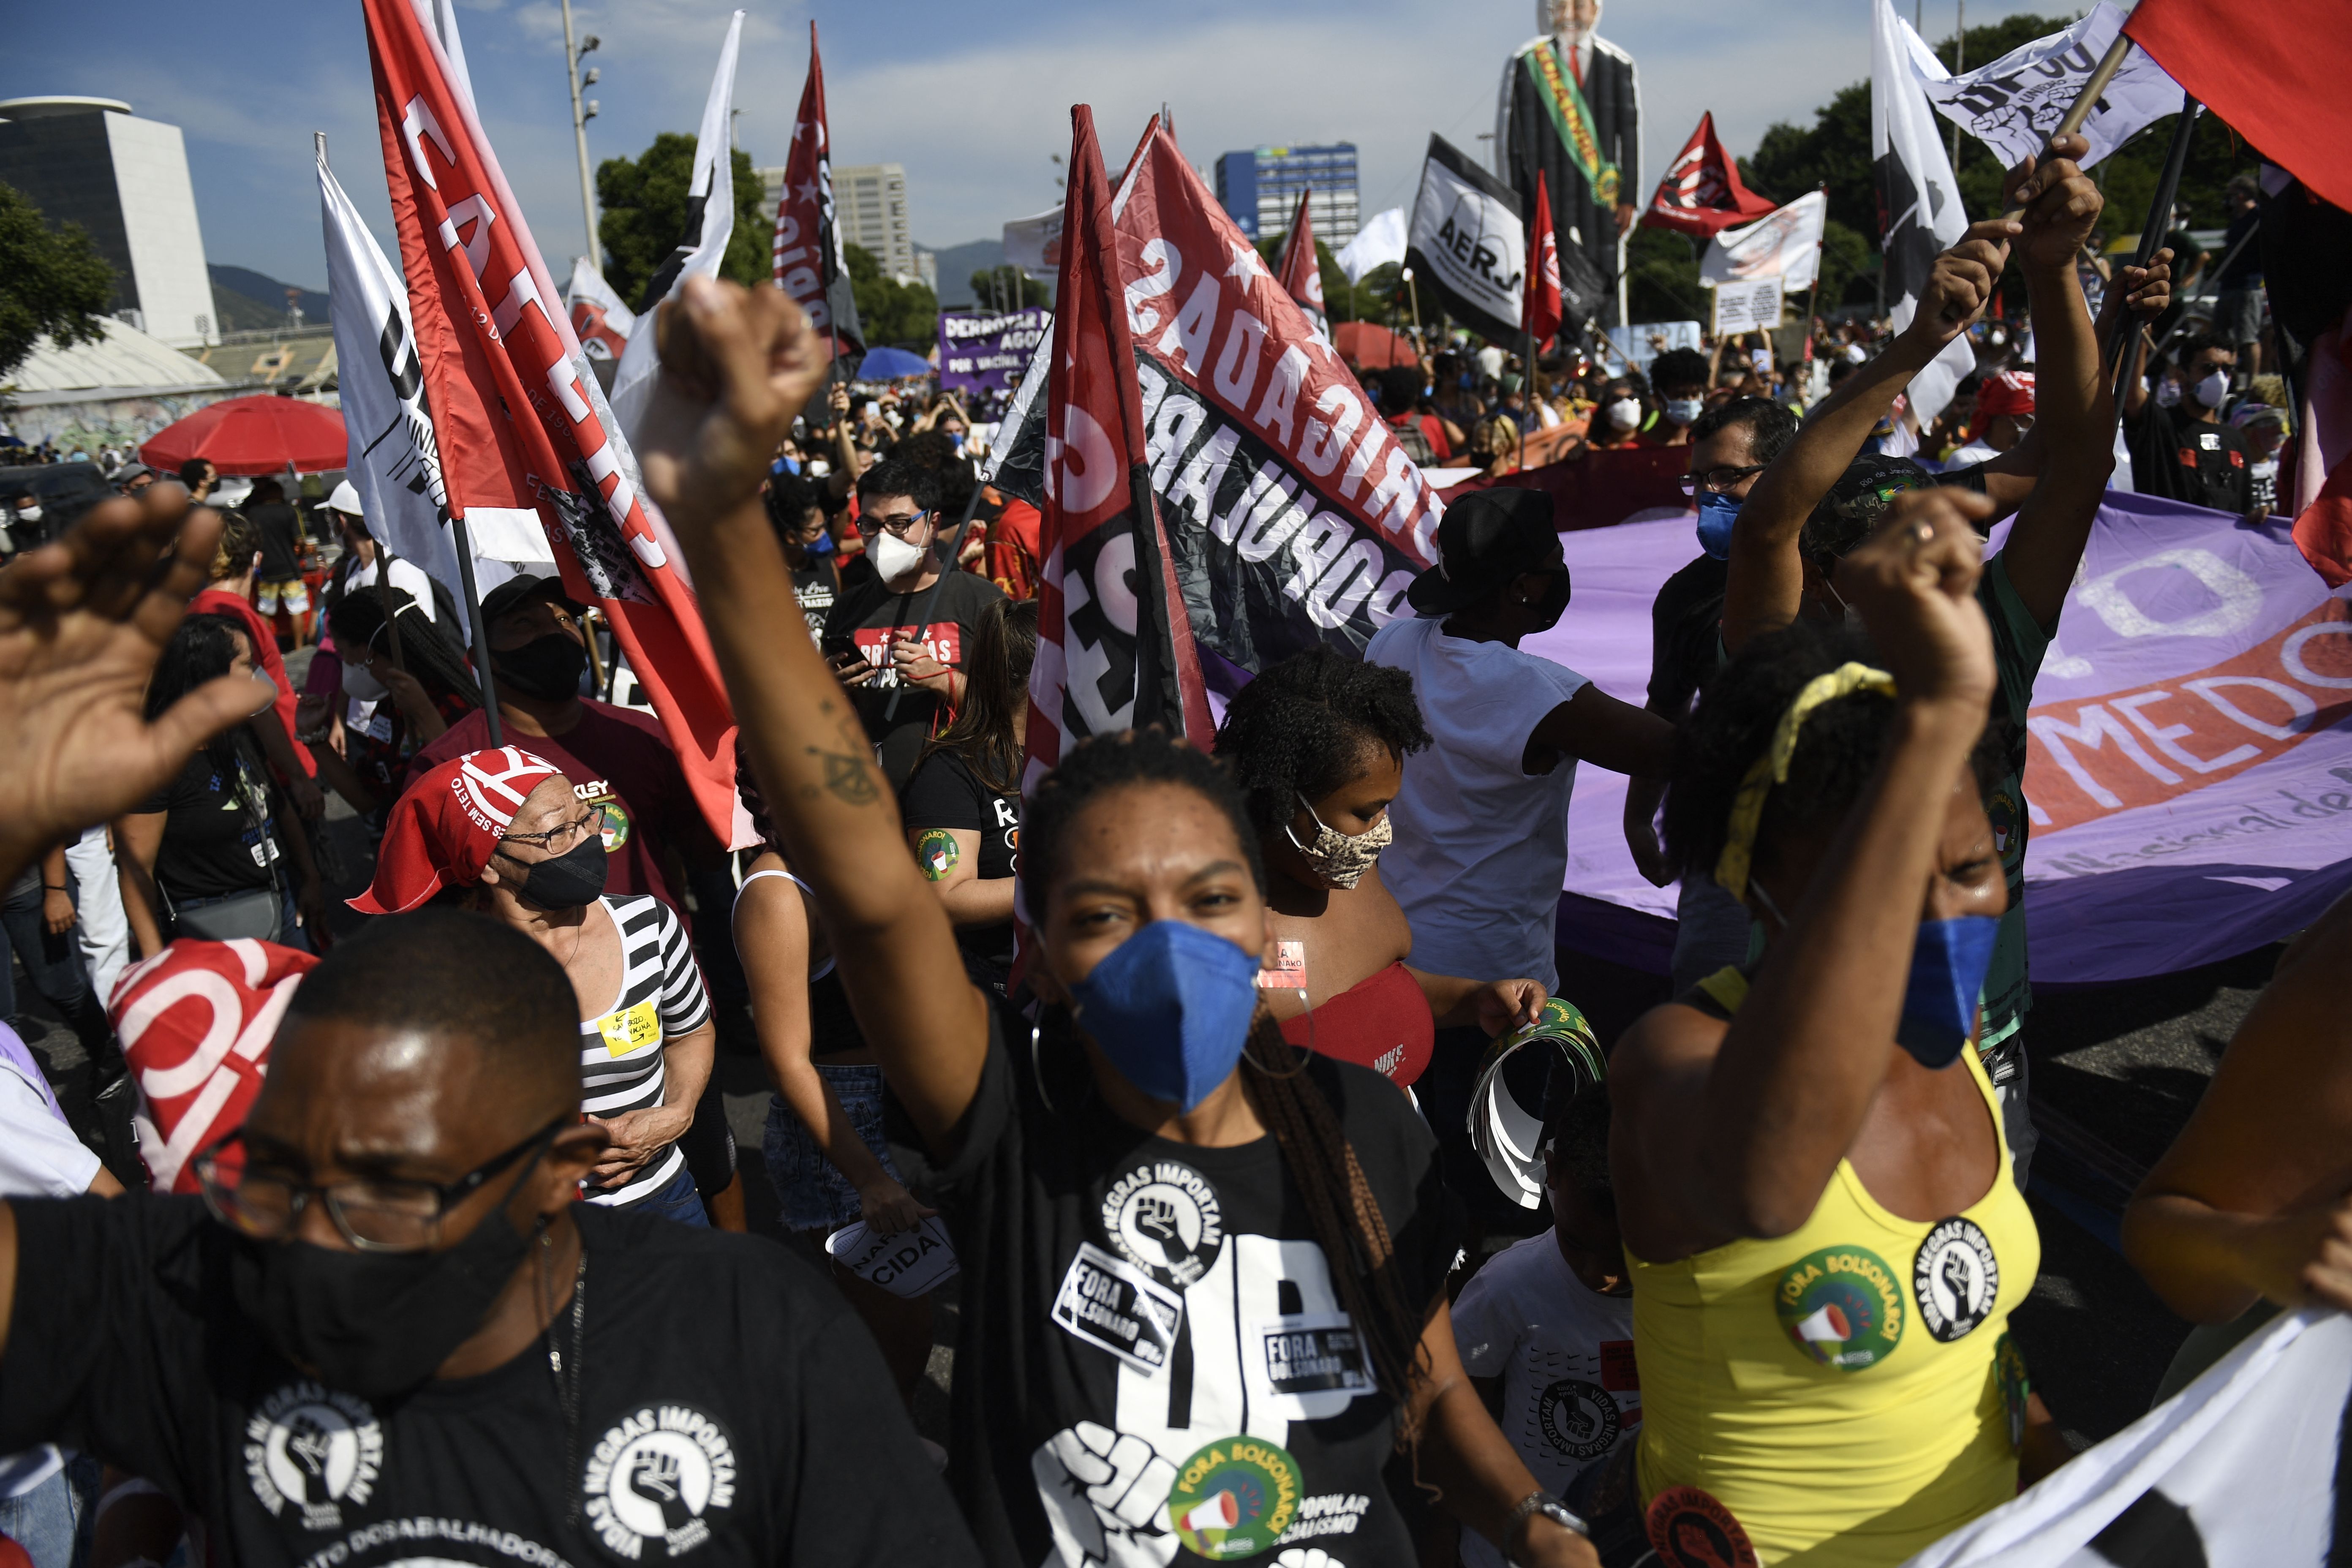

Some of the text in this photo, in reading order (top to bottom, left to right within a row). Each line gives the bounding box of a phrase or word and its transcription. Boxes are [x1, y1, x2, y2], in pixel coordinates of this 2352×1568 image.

[1439, 217, 1521, 291] AERJ
[1859, 477, 1873, 488] Rio
[451, 777, 468, 811] TETO
[468, 806, 493, 832] SEM
[629, 1021, 651, 1035] VACINA
[1102, 1165, 1153, 1230] NEGRAS
[1154, 1162, 1222, 1247] IMPORTAM
[872, 1236, 941, 1285] CIDA
[1076, 1262, 1122, 1310] FORA
[1916, 1220, 1998, 1334] VIDAS NEGRAS IMPORTAM
[1781, 1253, 1902, 1342] FORA BOLSONARO!
[1267, 1333, 1318, 1362] FORA
[583, 1407, 657, 1494] NEGRAS
[1542, 1388, 1616, 1456] VIDAS NEGRAS IMPORTAM
[658, 1405, 737, 1509] IMPORTAM
[1178, 1442, 1296, 1535] FORA BOLSONARO!
[585, 1494, 643, 1561] VIDAS
[1651, 1492, 1753, 1564] NEGRAS IMPORTAM
